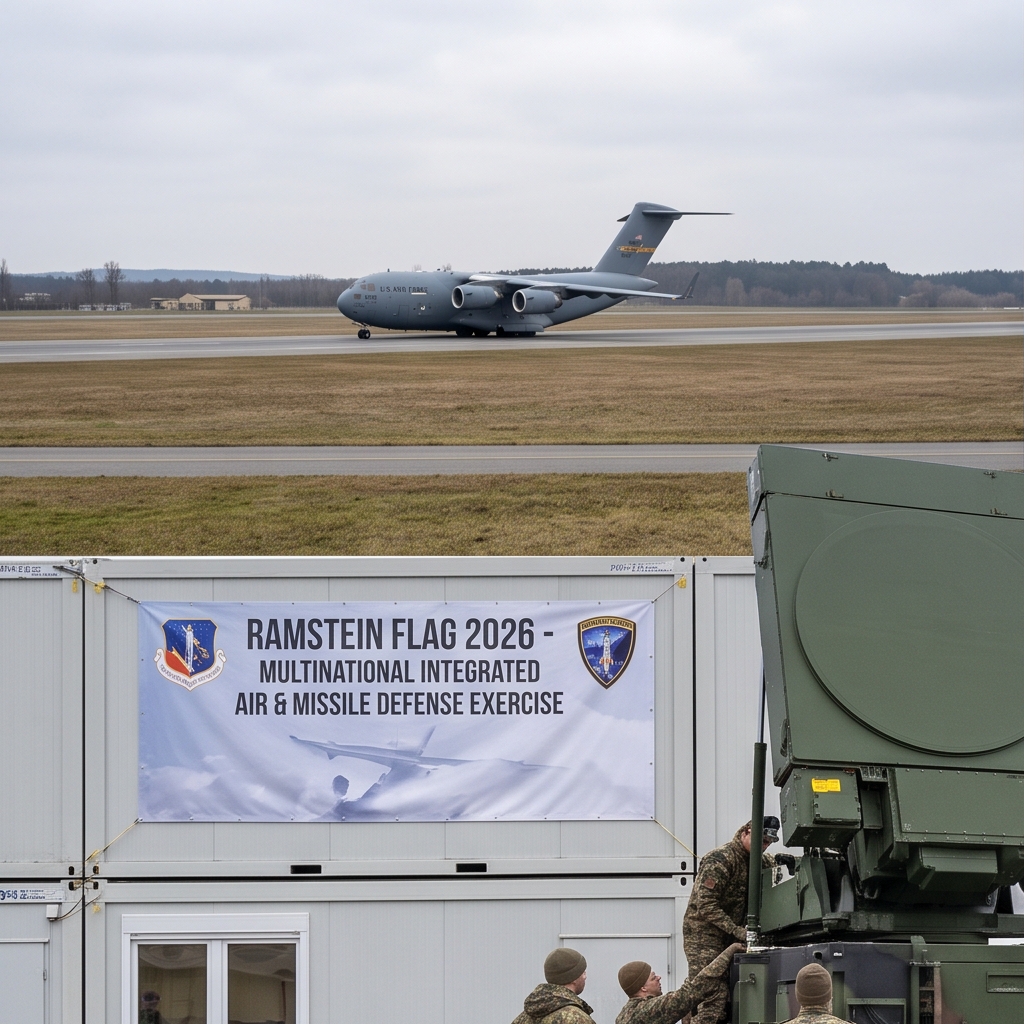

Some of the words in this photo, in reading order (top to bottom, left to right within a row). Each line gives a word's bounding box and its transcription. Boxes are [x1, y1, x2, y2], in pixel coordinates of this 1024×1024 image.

[247, 618, 383, 650] RAMSTEIN
[392, 618, 457, 650] FLAG
[465, 617, 535, 650] 2026
[259, 659, 415, 683] MULTINATIONAL
[421, 659, 540, 683] INTEGRATED
[234, 692, 268, 715] AIR
[274, 692, 288, 715] &
[293, 691, 371, 715] MISSILE
[377, 691, 464, 715] DEFENSE
[470, 691, 564, 715] EXERCISE
